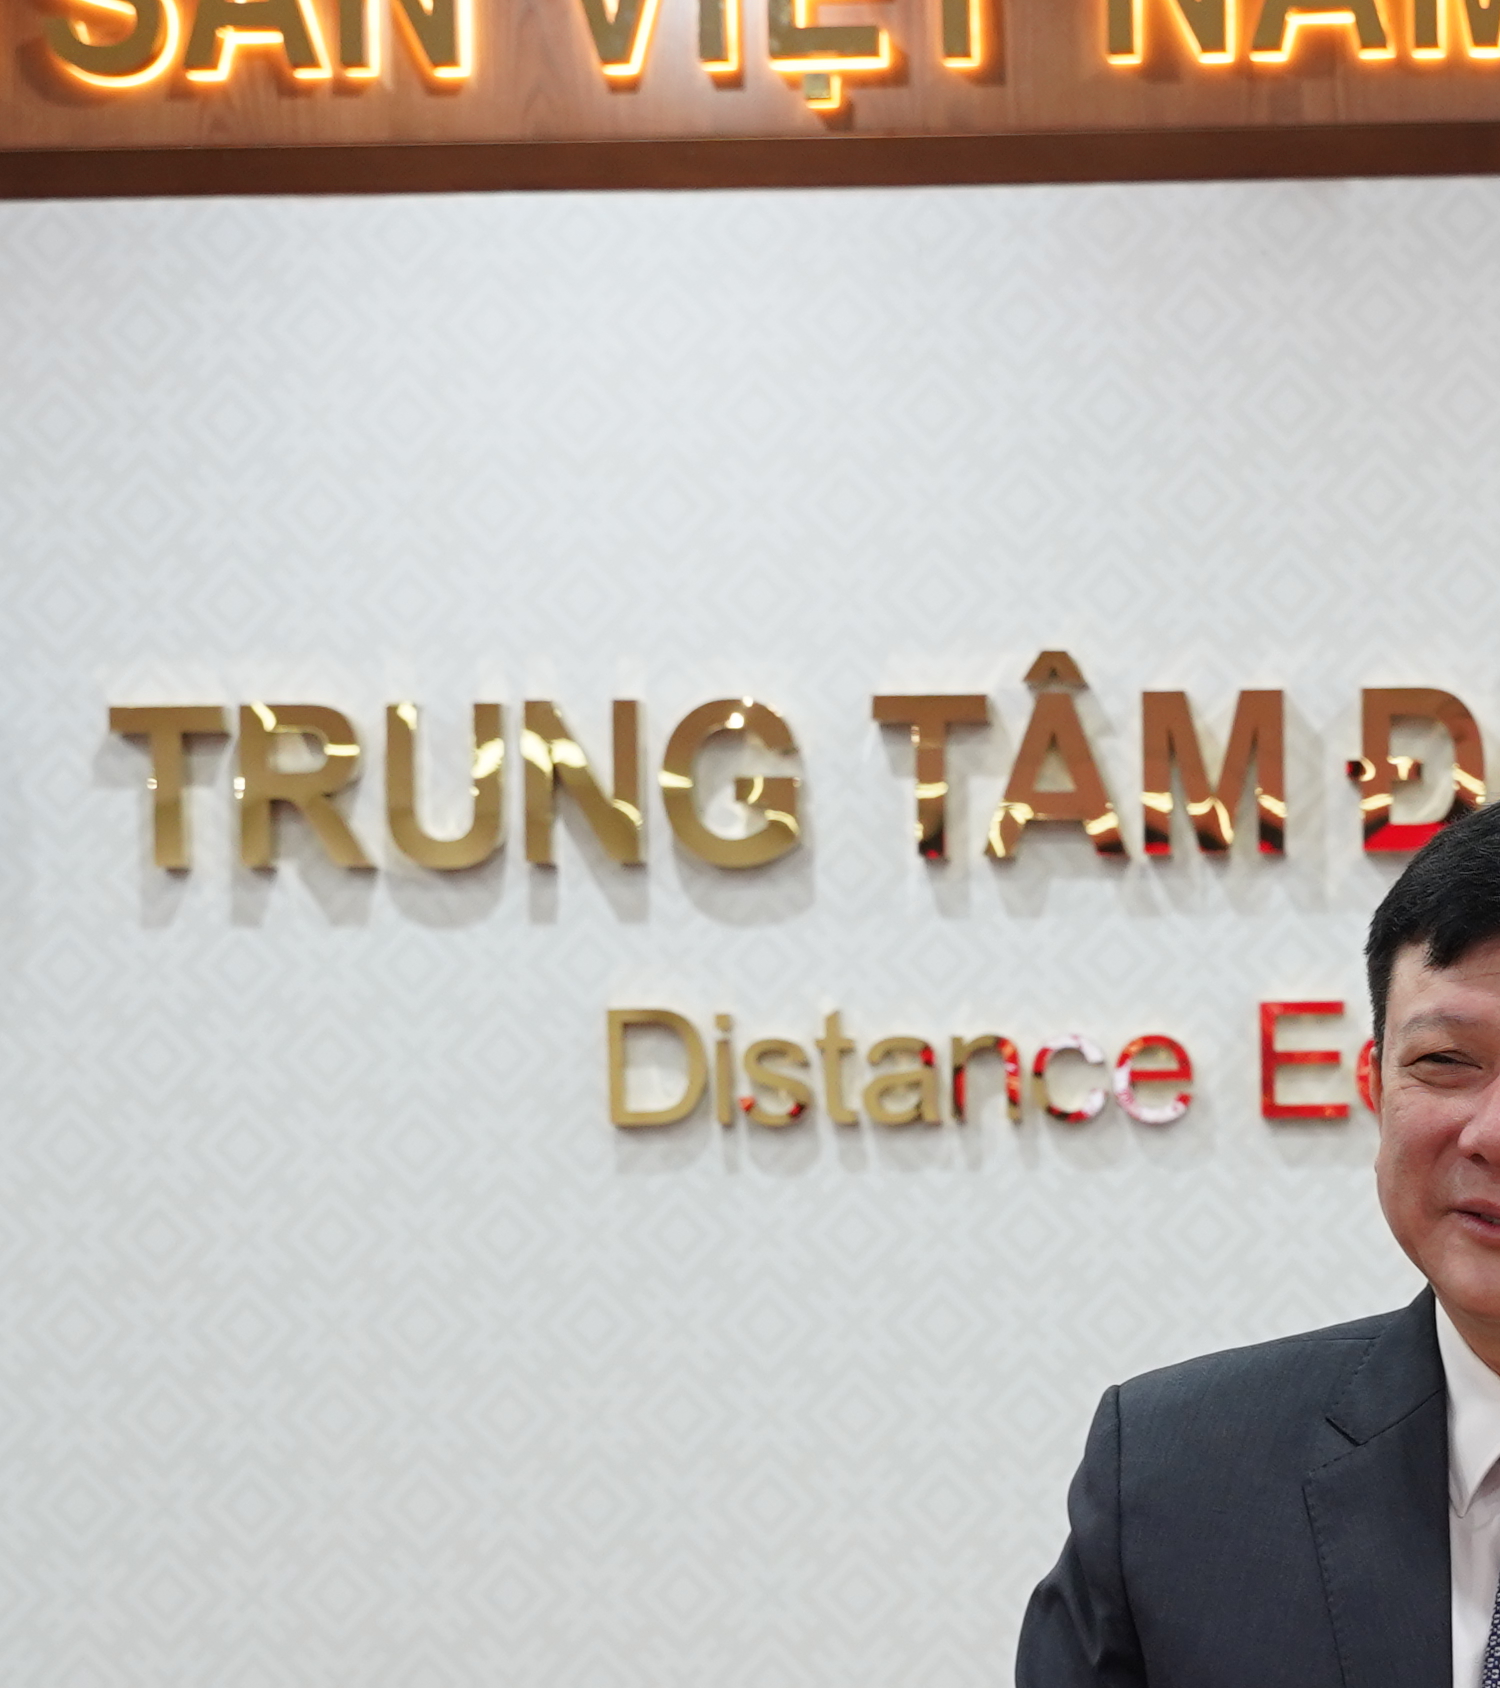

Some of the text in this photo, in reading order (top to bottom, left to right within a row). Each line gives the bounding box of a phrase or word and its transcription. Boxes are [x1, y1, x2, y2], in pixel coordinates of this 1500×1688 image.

[106, 695, 804, 872] TRUNG
[870, 649, 1290, 863] TÂM
[605, 1005, 1195, 1130] Distance
